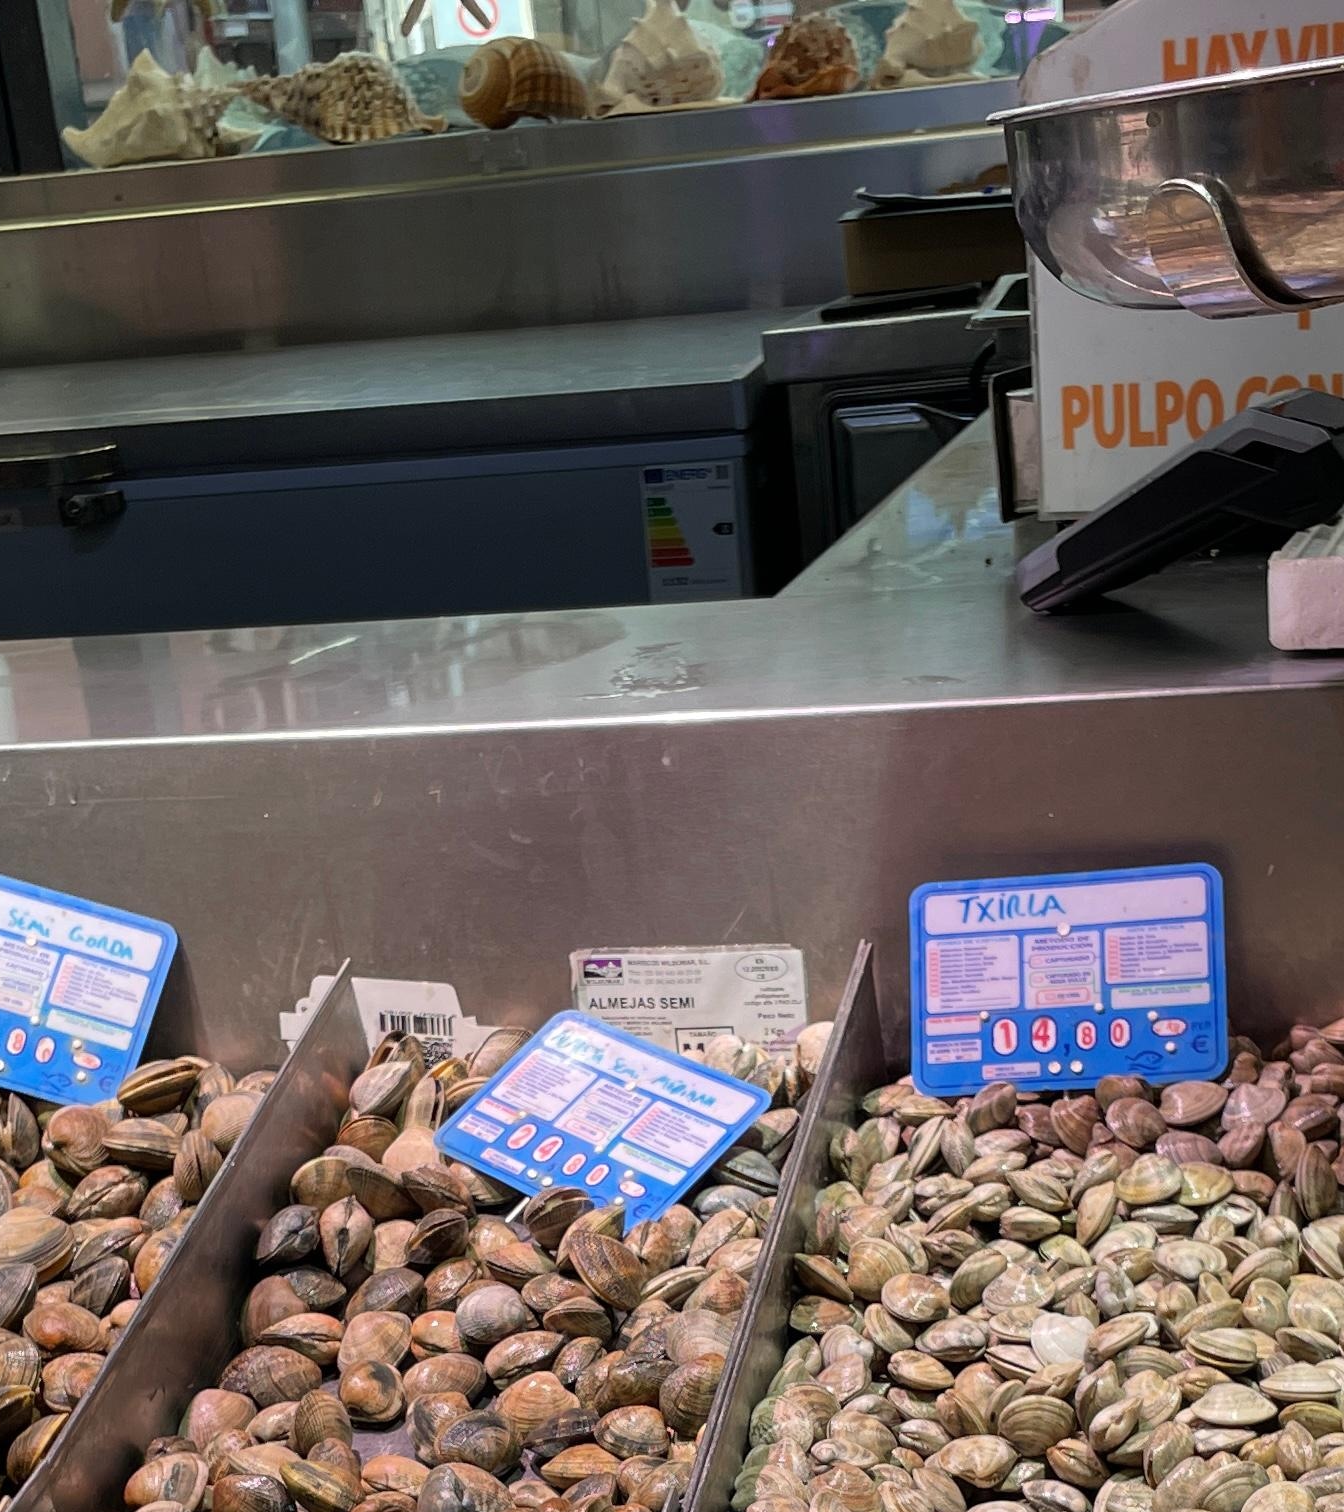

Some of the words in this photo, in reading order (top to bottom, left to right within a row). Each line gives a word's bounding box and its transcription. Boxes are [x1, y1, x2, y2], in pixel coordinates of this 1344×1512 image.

[1062, 377, 1226, 449] PULPO
[589, 997, 656, 1010] ALMEJAS
[660, 997, 695, 1010] SEMI
